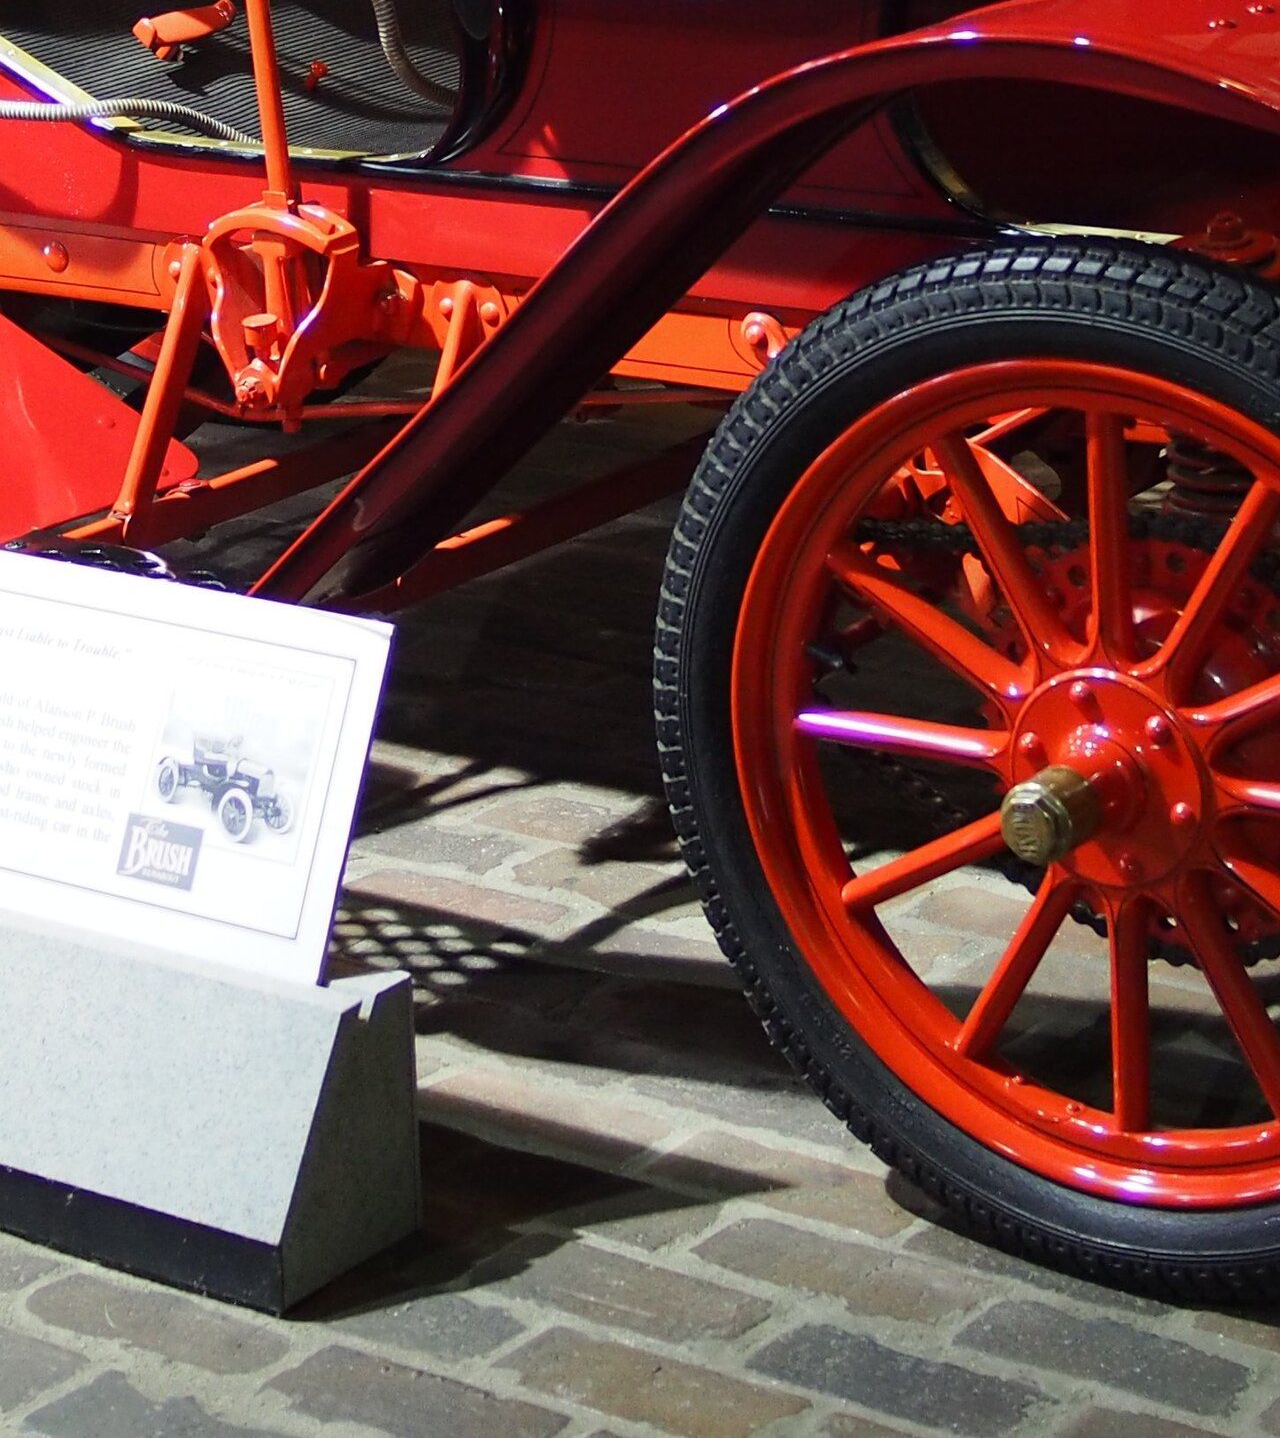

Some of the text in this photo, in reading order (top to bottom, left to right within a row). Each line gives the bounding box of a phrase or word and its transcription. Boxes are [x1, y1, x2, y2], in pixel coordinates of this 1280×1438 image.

[16, 626, 53, 646] Liable
[56, 637, 69, 650] to
[17, 695, 32, 710] of
[99, 711, 136, 732] Brush
[16, 716, 56, 738] helped
[57, 730, 109, 749] engineer
[112, 737, 132, 756] the
[2, 738, 16, 751] to
[18, 738, 38, 758] the
[41, 748, 78, 768] newly
[83, 753, 127, 777] formed
[15, 785, 49, 806] frame
[53, 797, 78, 813] and
[25, 769, 66, 786] owned
[71, 777, 101, 795] stock
[108, 785, 121, 799] in
[50, 820, 72, 834] car
[75, 825, 88, 839] in
[92, 825, 111, 844] the
